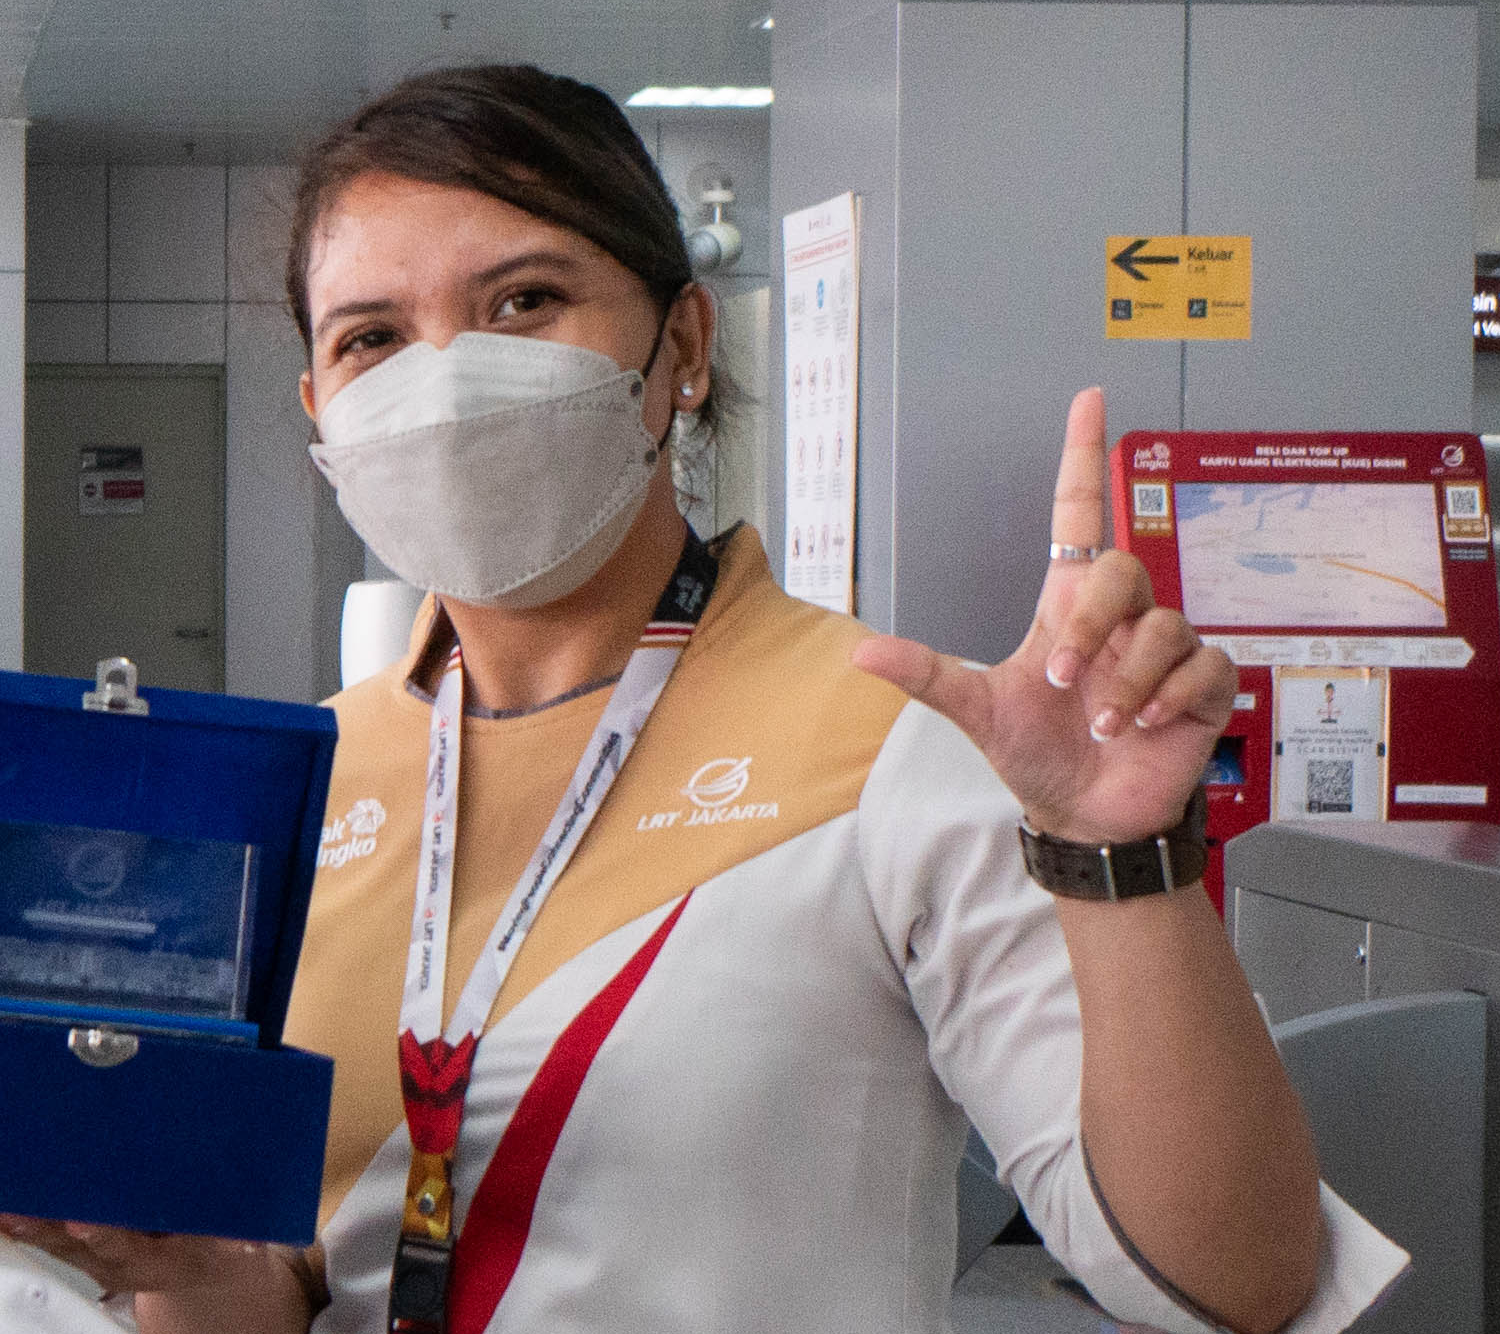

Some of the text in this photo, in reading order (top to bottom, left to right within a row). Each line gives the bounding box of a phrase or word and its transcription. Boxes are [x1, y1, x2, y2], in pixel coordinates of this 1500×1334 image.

[1187, 246, 1234, 261] Keluar
[1282, 447, 1306, 456] DAN
[1309, 447, 1331, 456] TOP
[1333, 447, 1349, 456] UP
[1200, 456, 1237, 467] KARTU
[1239, 457, 1270, 467] UANG
[1272, 457, 1339, 468] ELEKTRONIK
[636, 802, 779, 831] LRT JAKARTA
